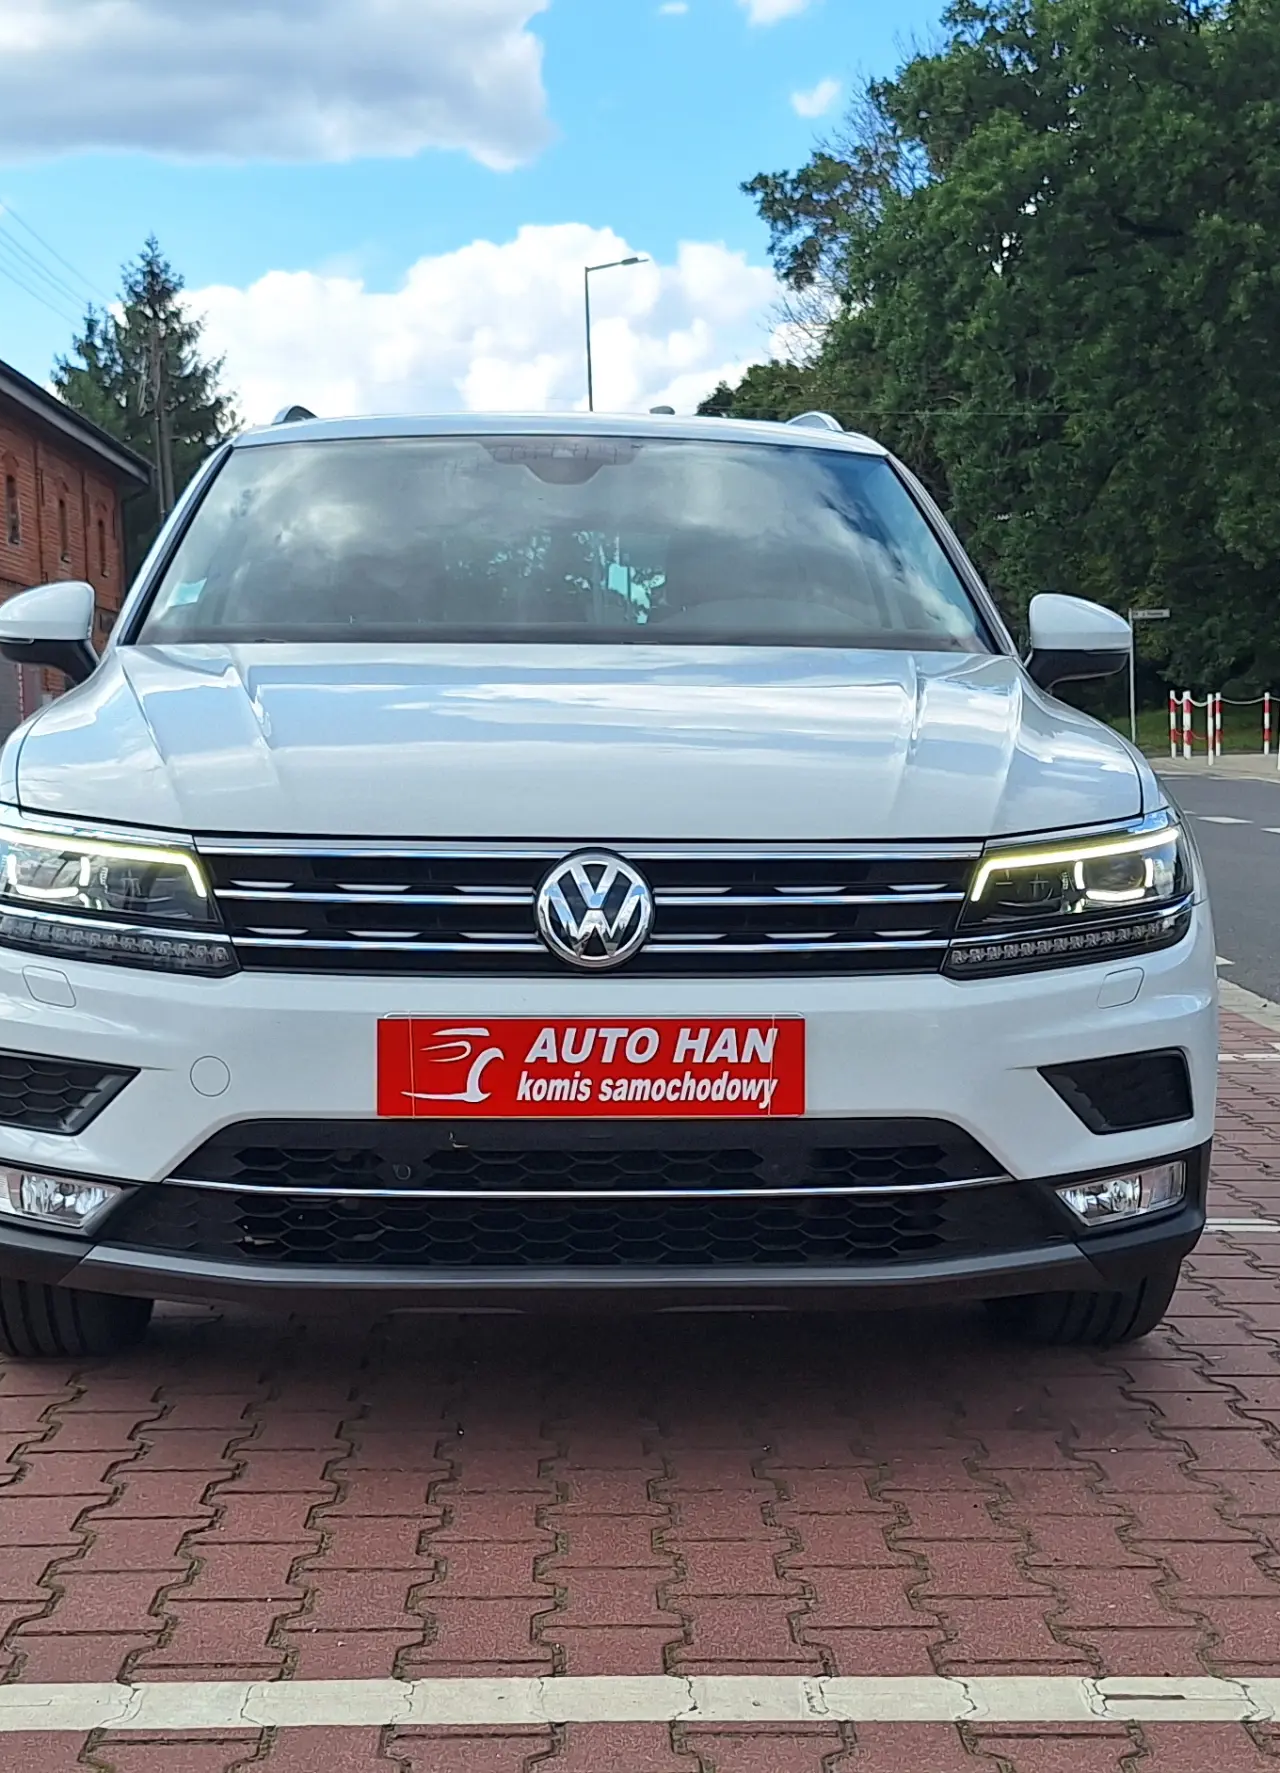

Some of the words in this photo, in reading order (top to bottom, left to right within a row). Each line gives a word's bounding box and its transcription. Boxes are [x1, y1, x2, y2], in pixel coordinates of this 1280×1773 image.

[542, 856, 648, 963] VW
[524, 1027, 660, 1064] AUTO
[672, 1027, 778, 1064] HAN
[516, 1070, 593, 1102] komis
[598, 1070, 779, 1109] samochodowy
